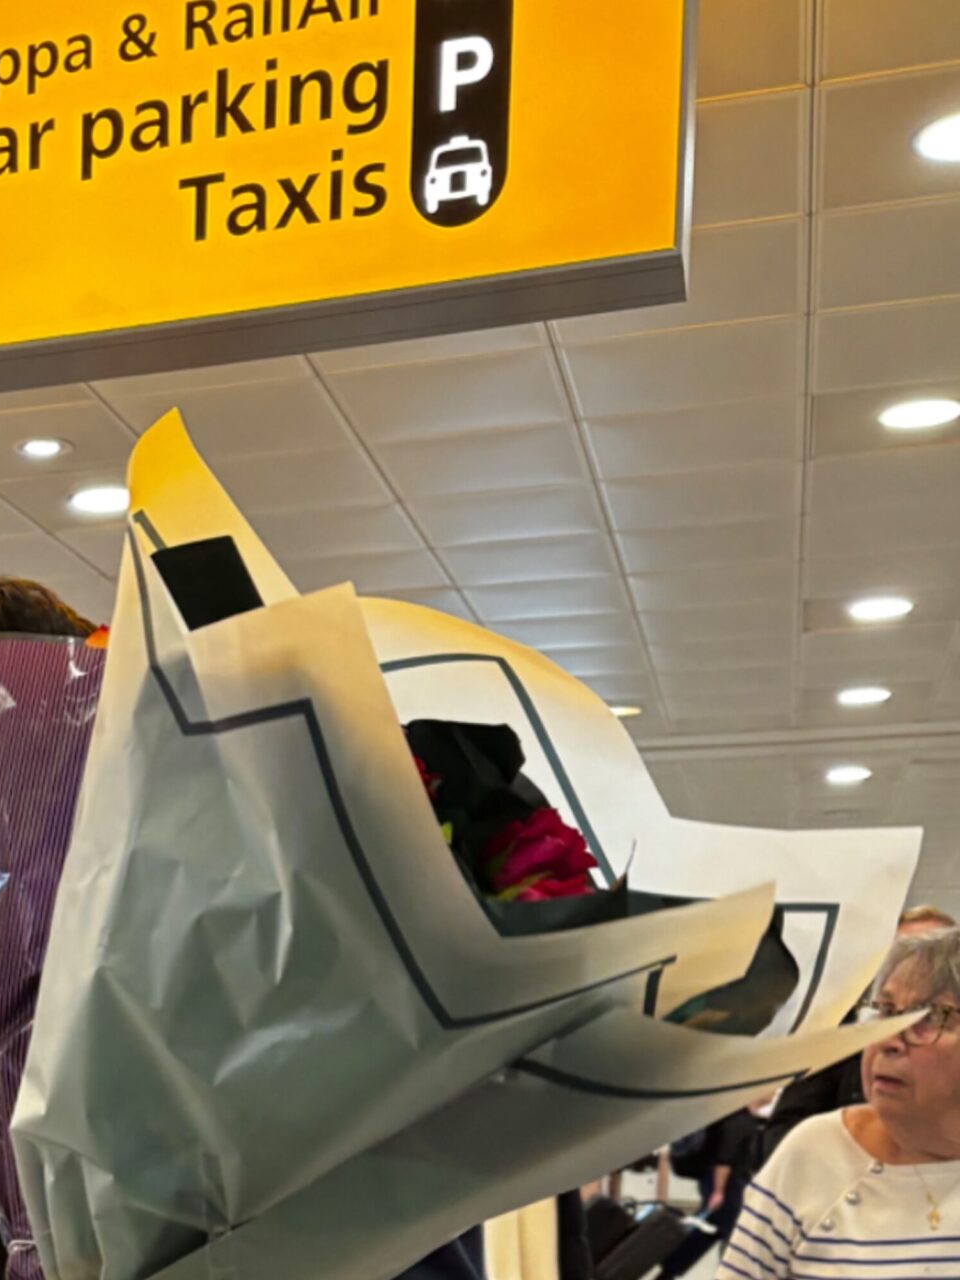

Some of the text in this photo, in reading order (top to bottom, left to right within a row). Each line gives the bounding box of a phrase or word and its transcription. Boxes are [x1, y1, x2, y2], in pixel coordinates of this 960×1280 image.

[117, 13, 158, 62] &
[439, 36, 494, 113] P
[80, 57, 390, 181] parking
[178, 149, 388, 242] Taxis
